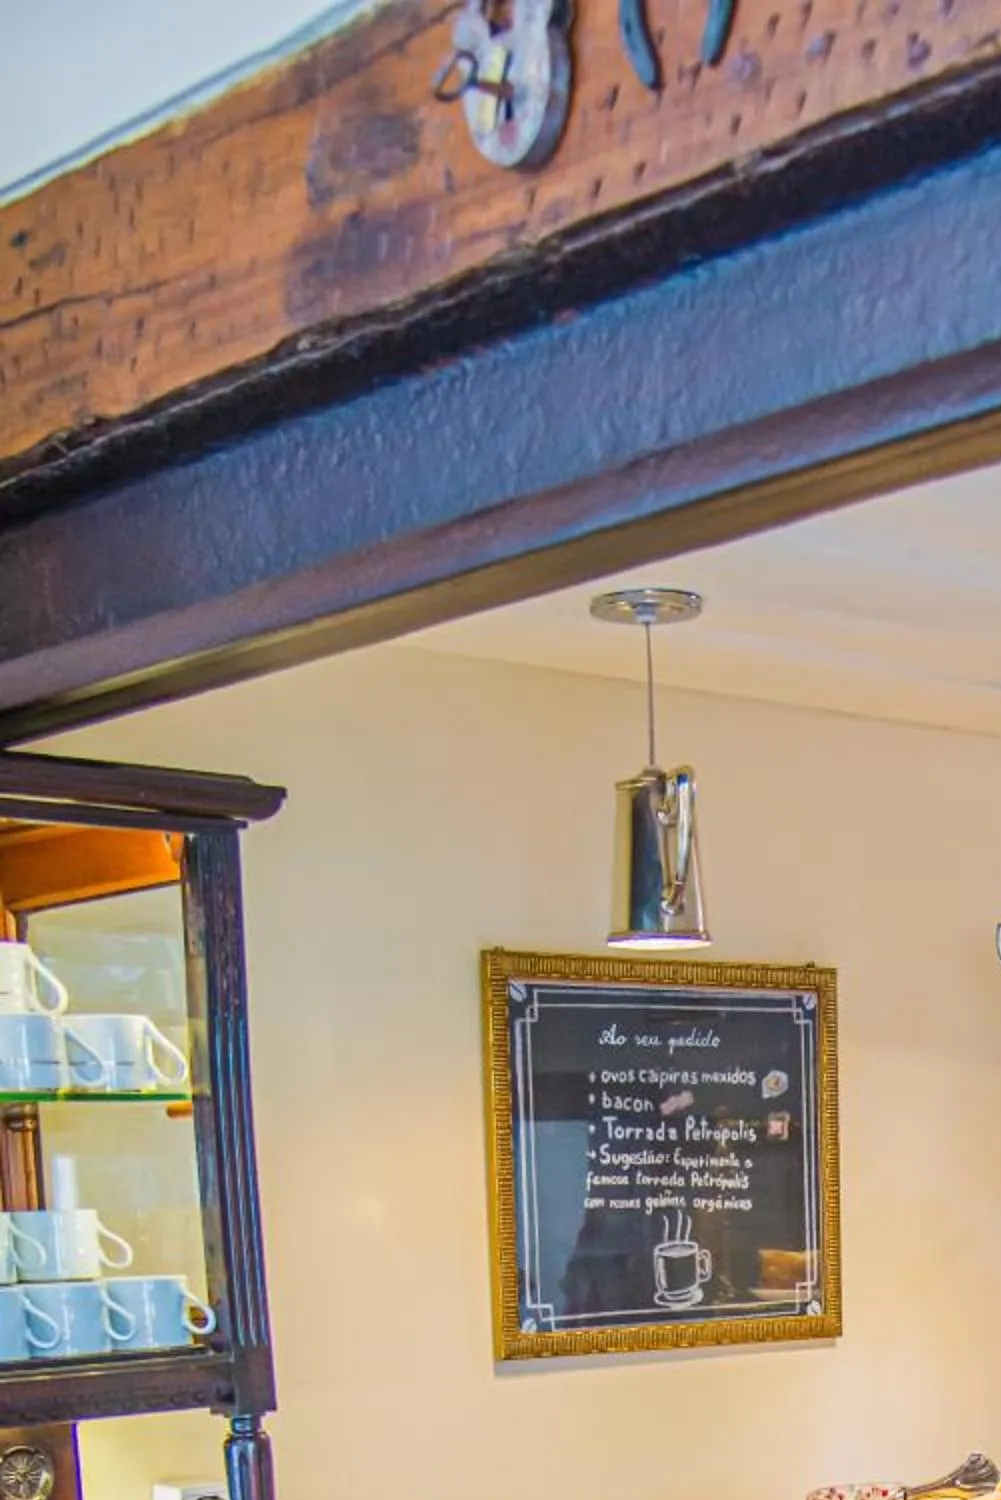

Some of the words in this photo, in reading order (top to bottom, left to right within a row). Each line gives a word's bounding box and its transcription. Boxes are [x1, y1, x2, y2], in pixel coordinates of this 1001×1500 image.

[601, 1069, 635, 1083] ovos
[701, 1066, 757, 1085] mexidos
[602, 1091, 654, 1112] bacon
[602, 1116, 678, 1141] Torrada
